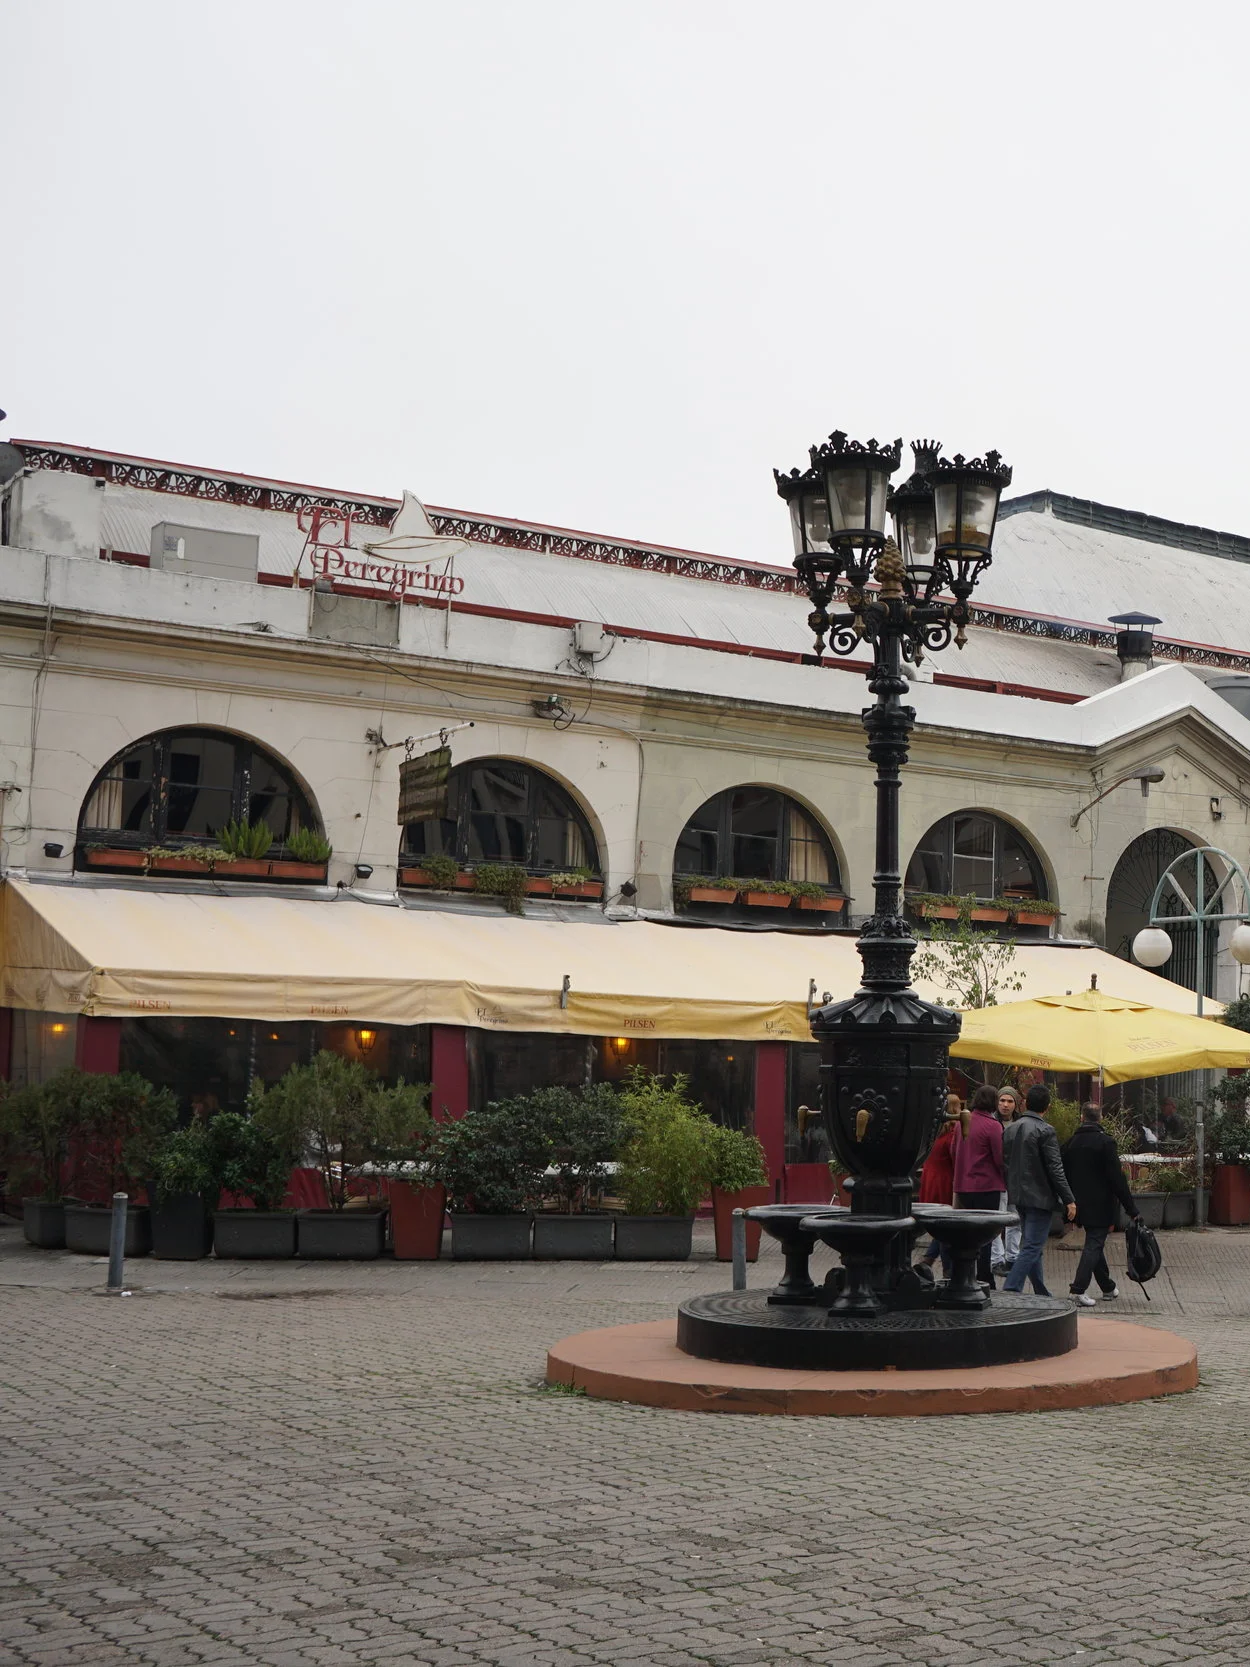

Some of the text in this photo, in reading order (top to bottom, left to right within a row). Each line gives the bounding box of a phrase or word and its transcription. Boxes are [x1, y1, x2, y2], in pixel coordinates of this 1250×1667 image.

[297, 505, 361, 549] El
[310, 548, 465, 597] Peregrino
[129, 999, 172, 1010] PILSEN
[623, 1018, 656, 1029] PILSEN
[1030, 1056, 1052, 1068] PILSEN
